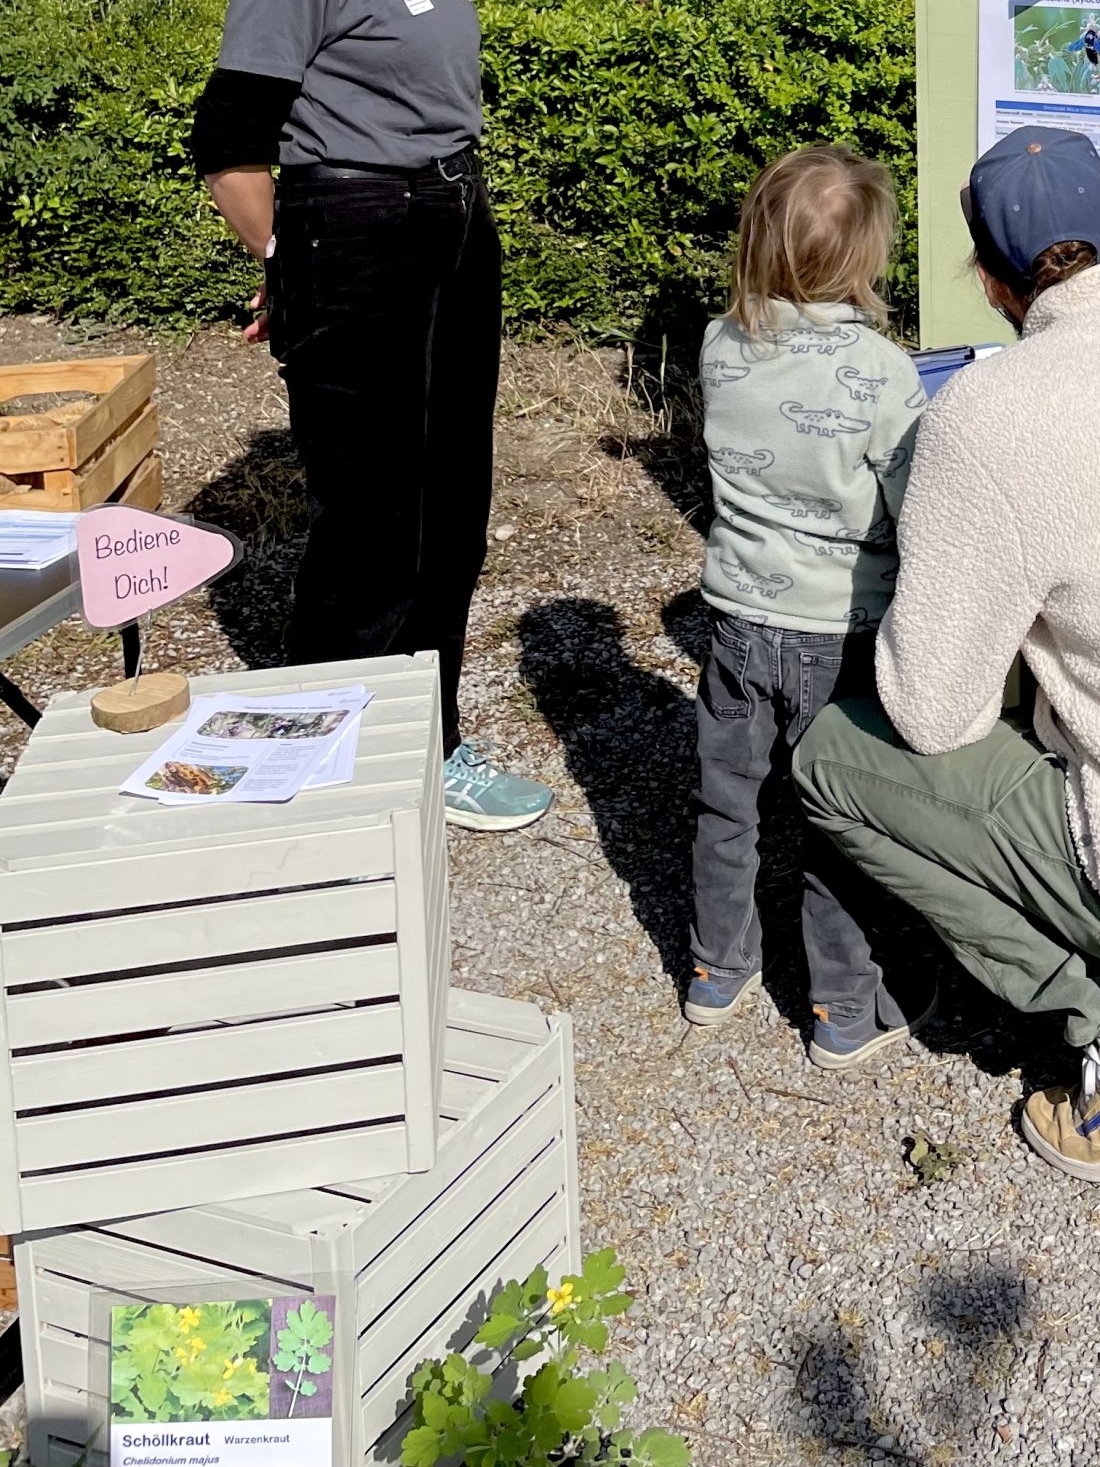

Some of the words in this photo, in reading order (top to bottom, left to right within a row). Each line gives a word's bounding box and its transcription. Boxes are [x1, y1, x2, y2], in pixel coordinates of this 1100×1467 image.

[95, 528, 181, 560] Bediene
[114, 565, 169, 600] Dich!
[122, 1432, 211, 1448] Schöllkraut
[223, 1434, 291, 1445] Warzenkraut
[122, 1455, 187, 1467] Chelidonium
[188, 1455, 220, 1467] majus
